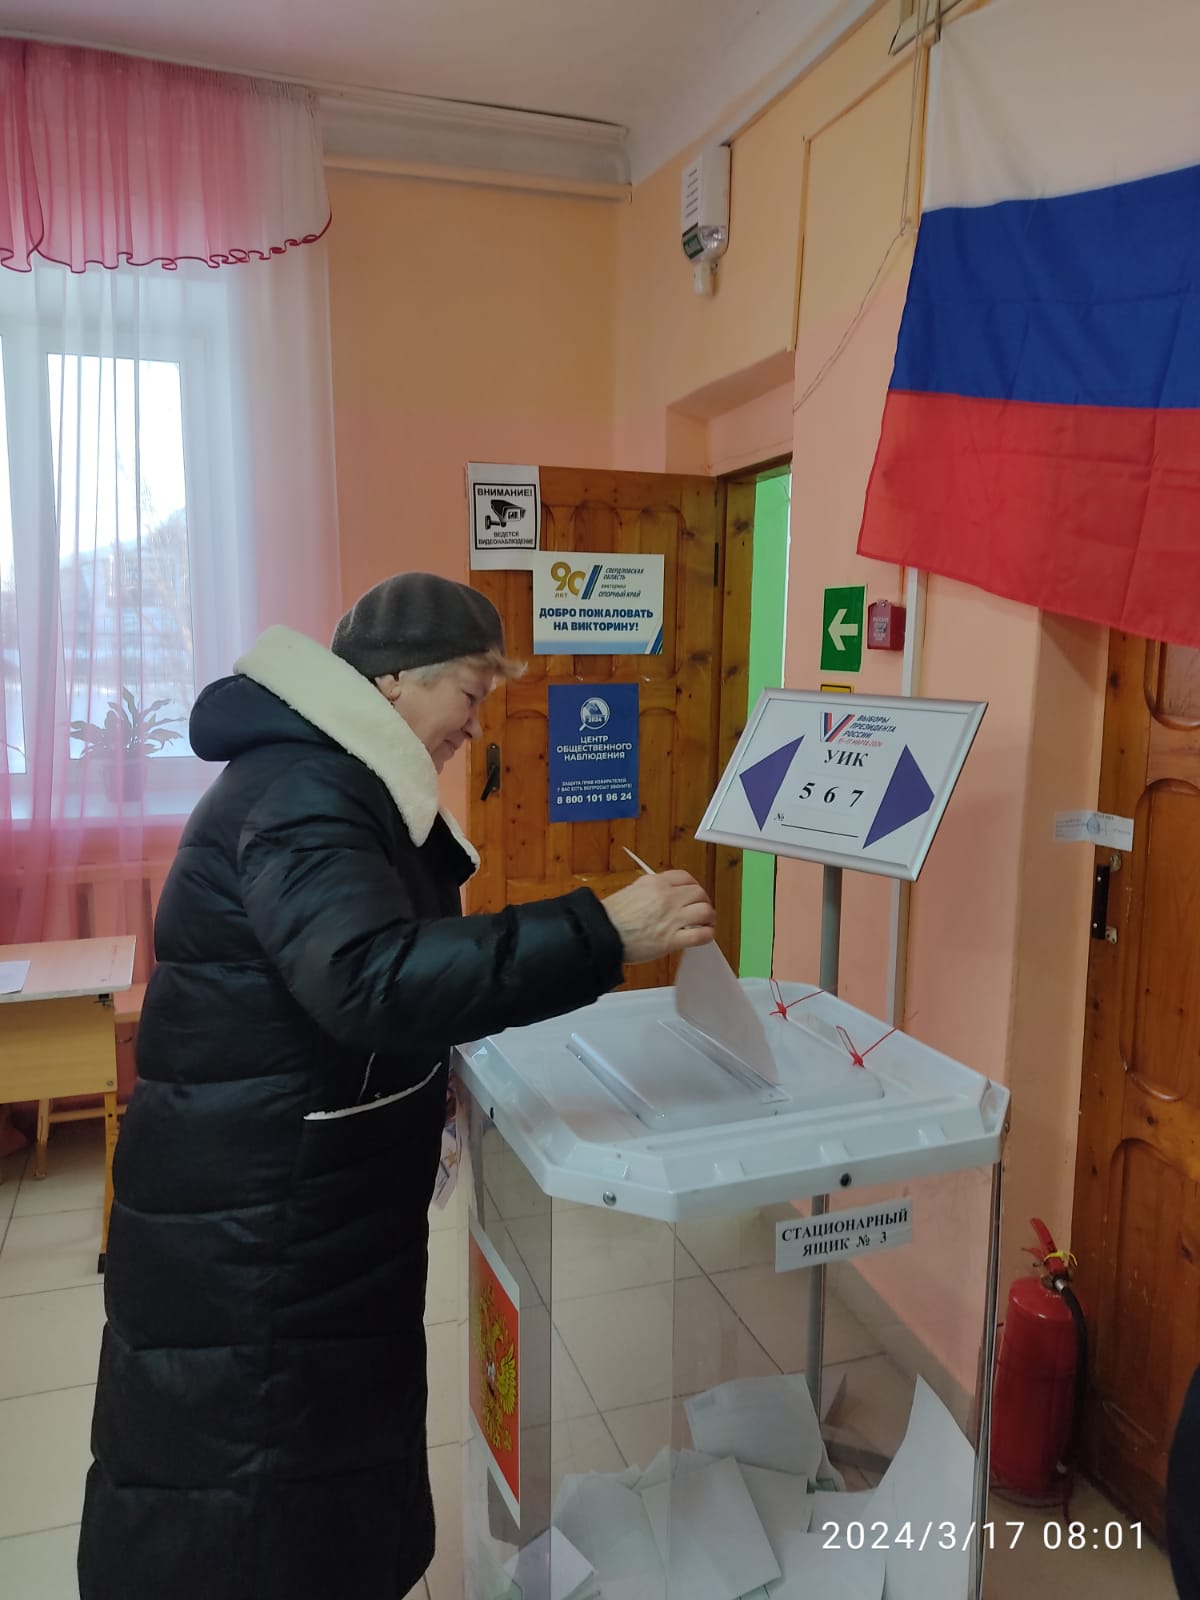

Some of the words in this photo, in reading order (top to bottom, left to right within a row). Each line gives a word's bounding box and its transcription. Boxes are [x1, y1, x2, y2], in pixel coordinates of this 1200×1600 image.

[477, 488, 533, 497] ВНИМАНИЕ!
[539, 608, 576, 619] ДОБРО
[579, 608, 654, 619] ПОЖАЛОВАТЬ
[553, 622, 569, 631] НА
[571, 622, 639, 632] ВИКТОРИНУ!
[857, 714, 891, 723] ВЫБОРЫ
[850, 722, 897, 733] ПРЕЗИДЕНТА
[580, 735, 609, 744] ЦЕНТР
[843, 730, 873, 739] РОССИИ
[556, 743, 632, 753] ОБЩЕСТВЕННОГО
[564, 751, 625, 761] НАБЛЮДЕНИЯ
[824, 749, 869, 768] УИК
[557, 796, 563, 805] 8
[566, 794, 584, 804] 800
[586, 793, 603, 803] 101
[606, 792, 618, 801] 96
[620, 791, 632, 801] 24
[782, 1208, 908, 1242] СТАЦИОНАРНЫЙ
[802, 1237, 850, 1257] ЯЩИК
[856, 1233, 871, 1249] №
[879, 1231, 887, 1244] 3
